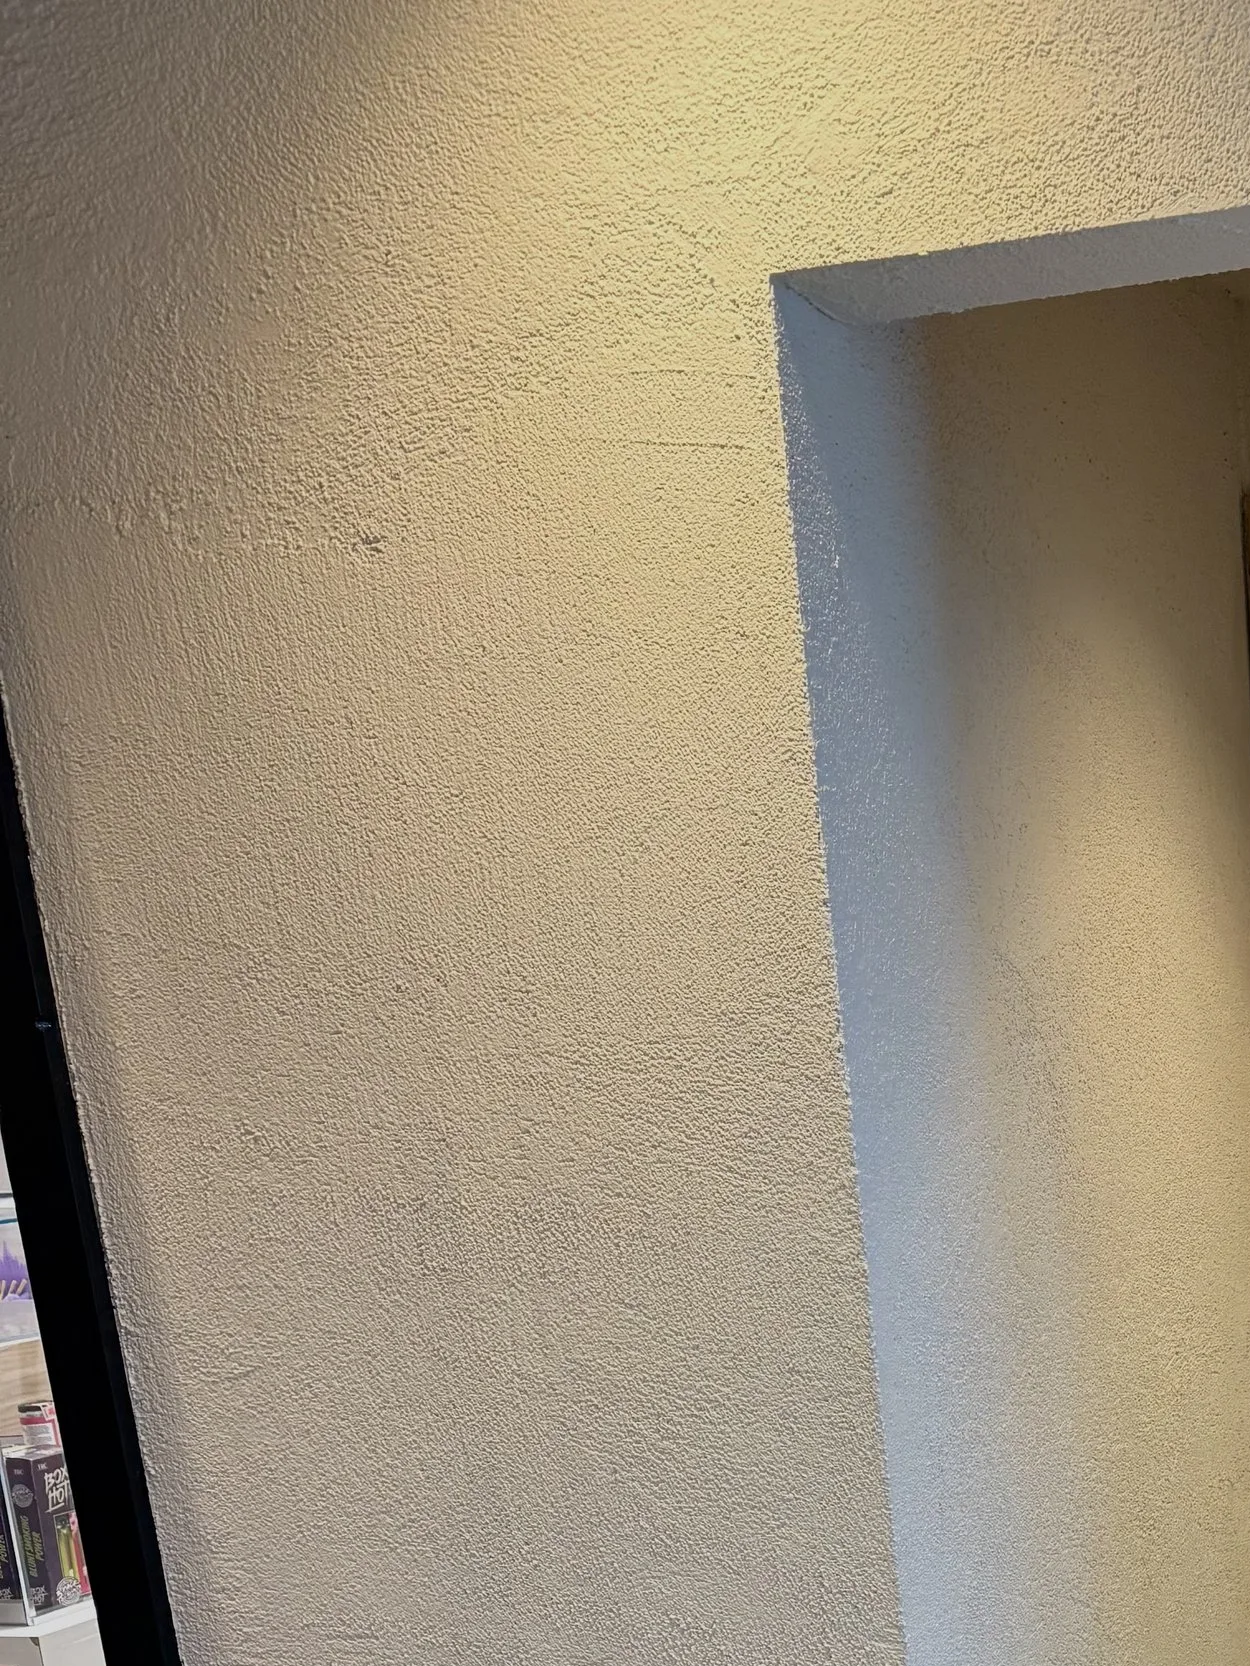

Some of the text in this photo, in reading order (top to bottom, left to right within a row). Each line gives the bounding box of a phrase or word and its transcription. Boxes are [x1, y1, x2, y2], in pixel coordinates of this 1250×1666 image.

[44, 1465, 69, 1494] BOX
[47, 1480, 70, 1511] HOT
[31, 1531, 45, 1561] POWER
